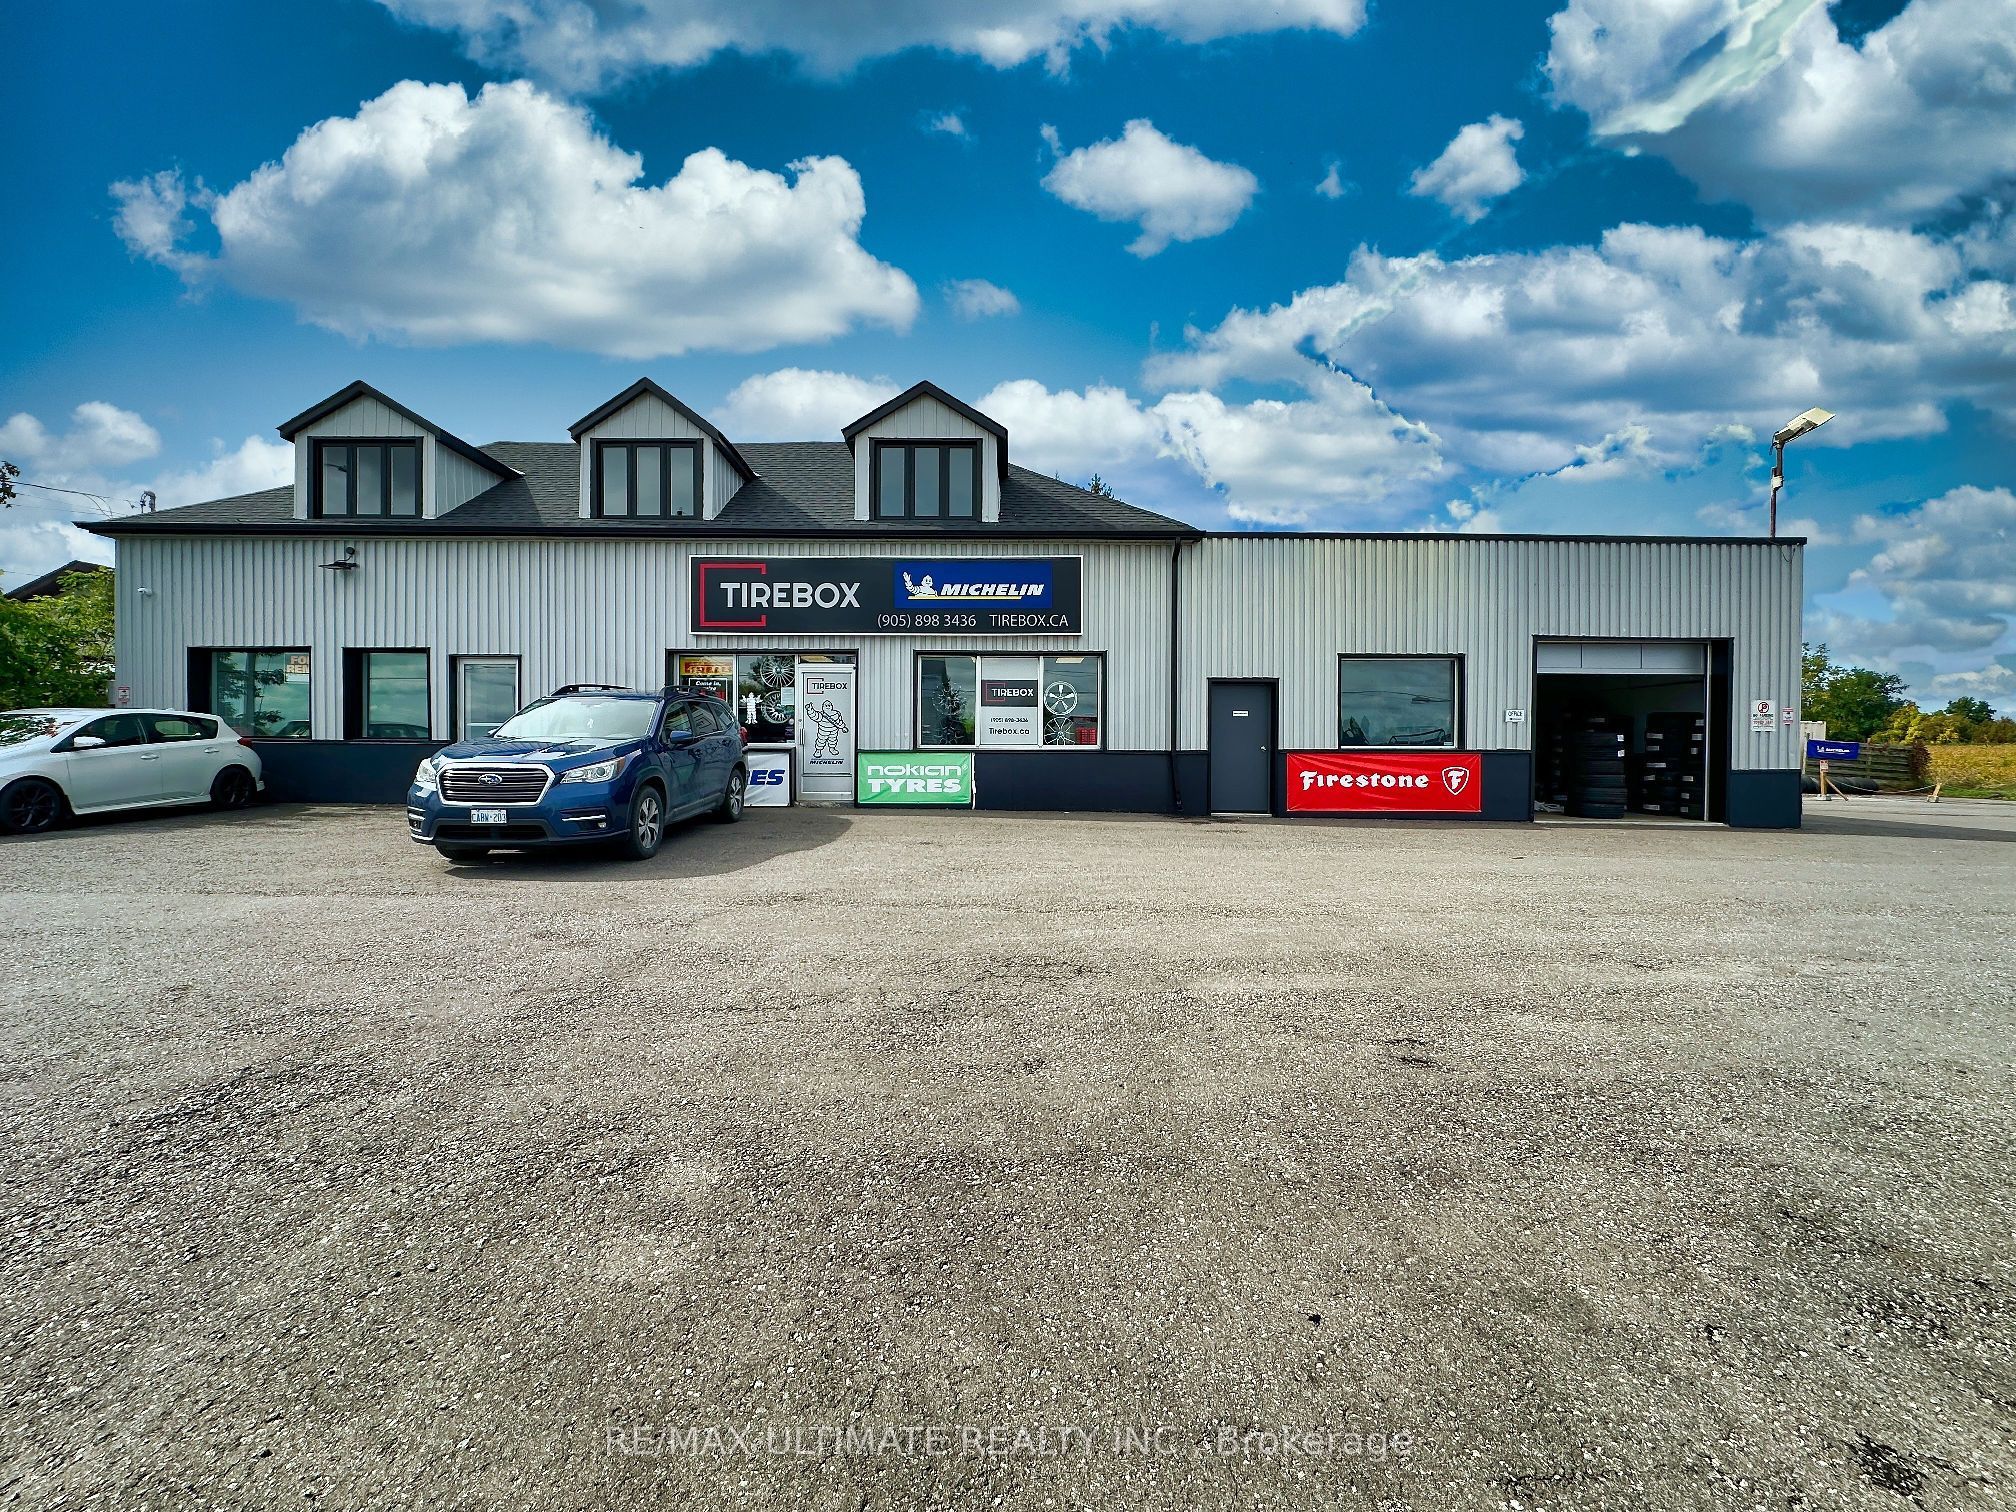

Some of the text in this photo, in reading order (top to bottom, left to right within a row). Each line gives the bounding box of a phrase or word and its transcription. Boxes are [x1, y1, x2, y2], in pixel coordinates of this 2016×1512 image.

[719, 582, 861, 609] TIREBOX
[940, 583, 1045, 596] MICHELIN
[877, 614, 977, 628] (905) 898 3436
[989, 614, 1069, 627] TIREBOX.CA
[811, 682, 848, 690] TIREBOX
[991, 688, 1034, 697] TIREBOX
[988, 727, 1030, 735] Tirebox.ca
[867, 778, 962, 793] TYRES
[1299, 770, 1430, 791] Firestone
